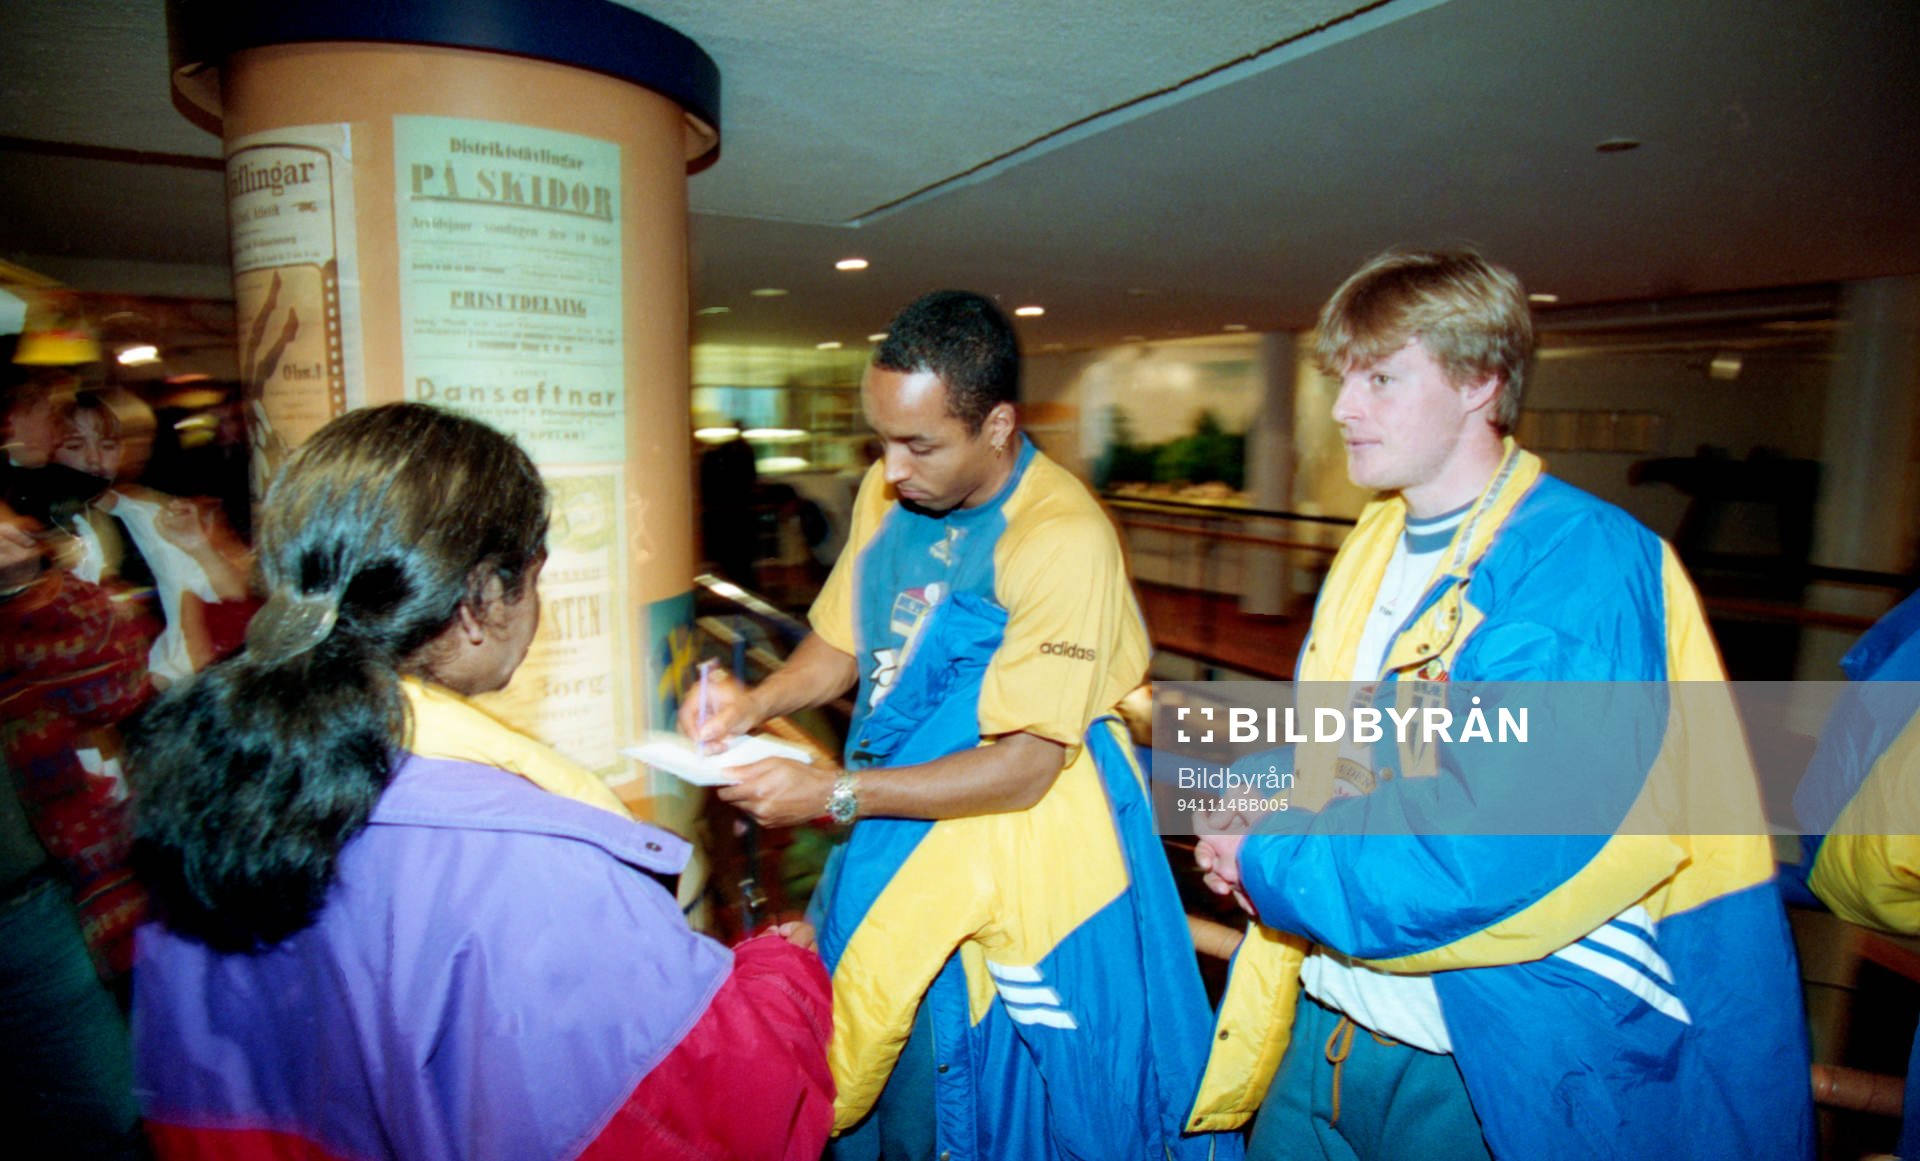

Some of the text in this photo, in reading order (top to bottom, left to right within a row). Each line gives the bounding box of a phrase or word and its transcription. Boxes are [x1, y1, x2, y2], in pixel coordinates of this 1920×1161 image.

[411, 160, 613, 219] PÅ SKIDOR
[450, 290, 587, 316] PRISUTDELNING
[416, 377, 616, 407] Dansaftnar
[548, 594, 600, 641] STEN
[1039, 640, 1096, 661] adidas
